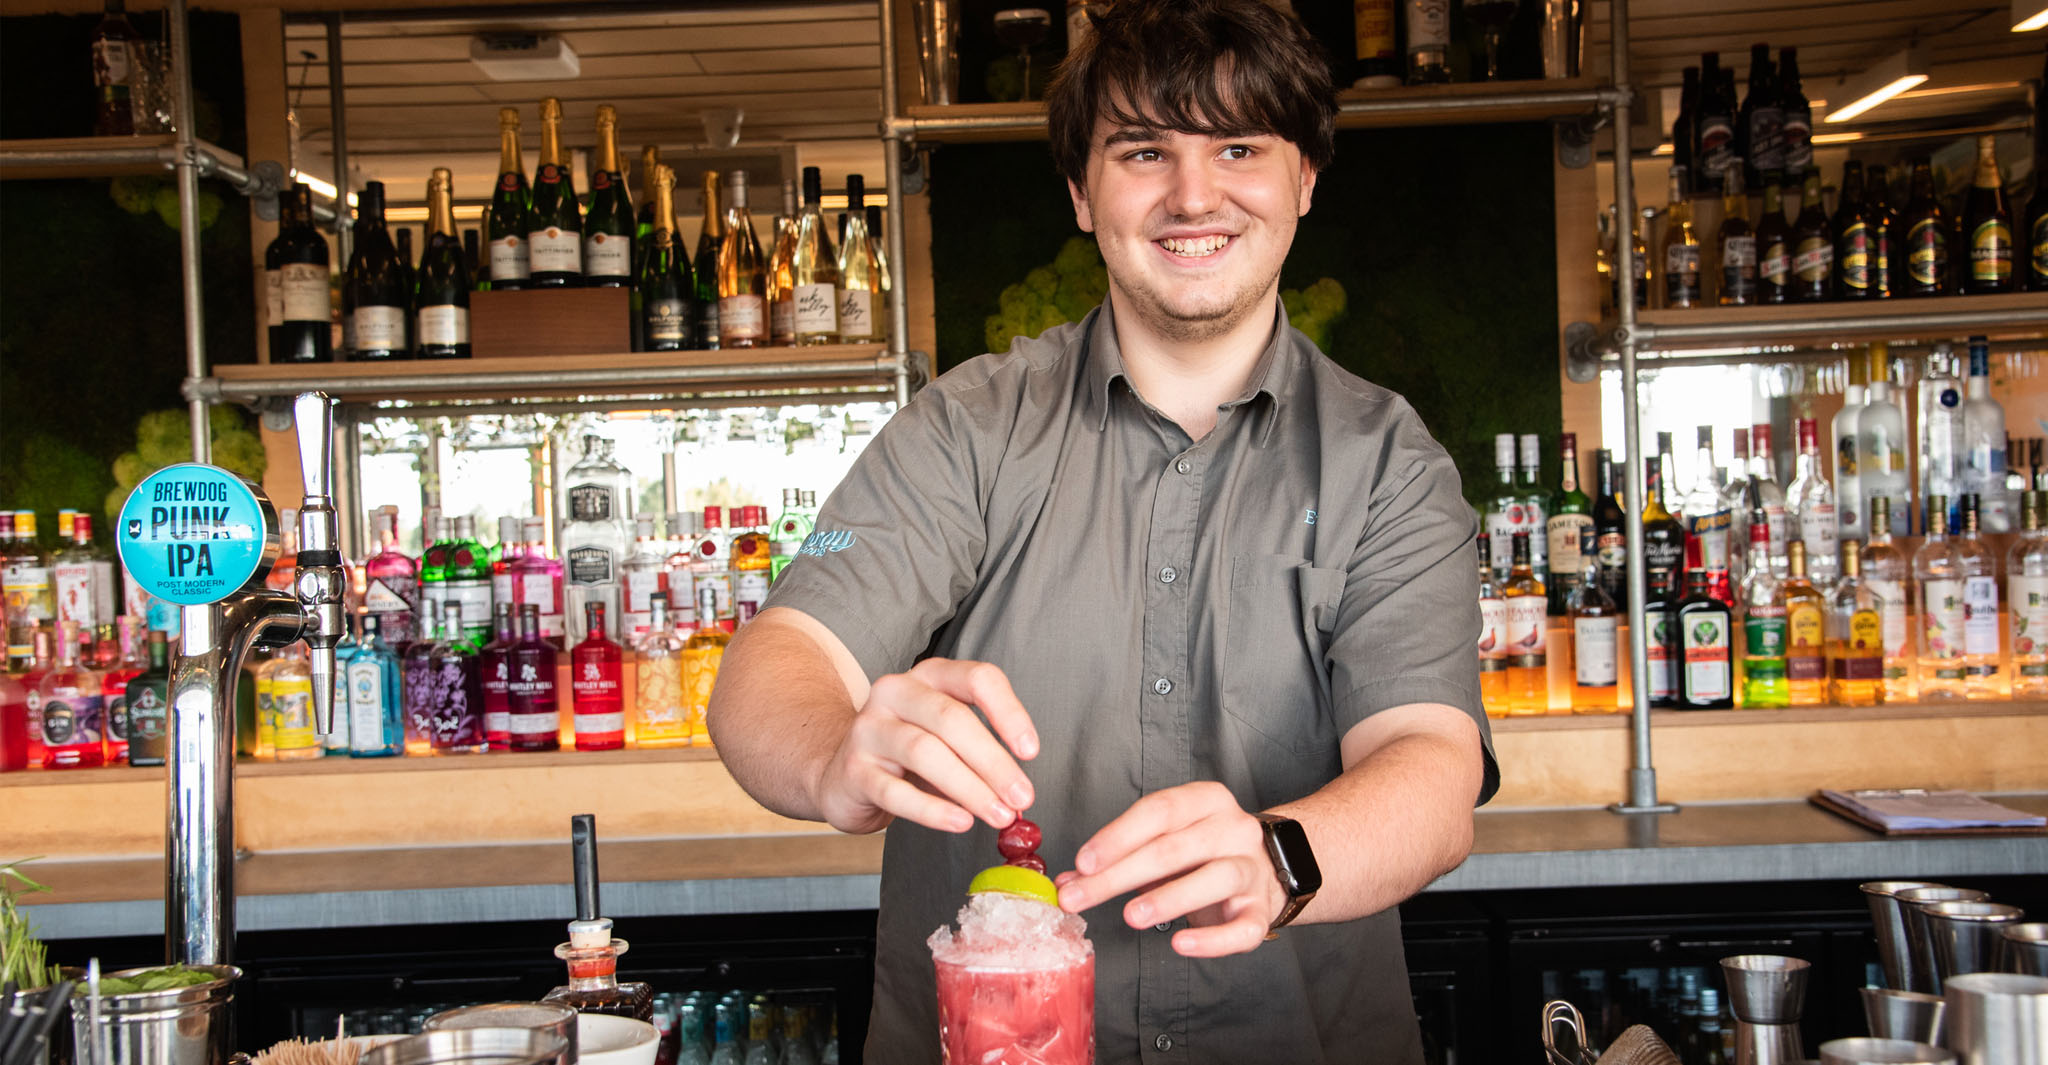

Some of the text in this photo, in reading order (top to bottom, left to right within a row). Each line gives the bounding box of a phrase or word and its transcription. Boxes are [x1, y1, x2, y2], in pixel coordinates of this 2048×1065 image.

[153, 481, 227, 502] BREWDOG
[151, 506, 231, 540] PUNK
[167, 543, 214, 577] IPA
[157, 579, 225, 589] POST MODERN
[171, 587, 212, 596] CLASSIC
